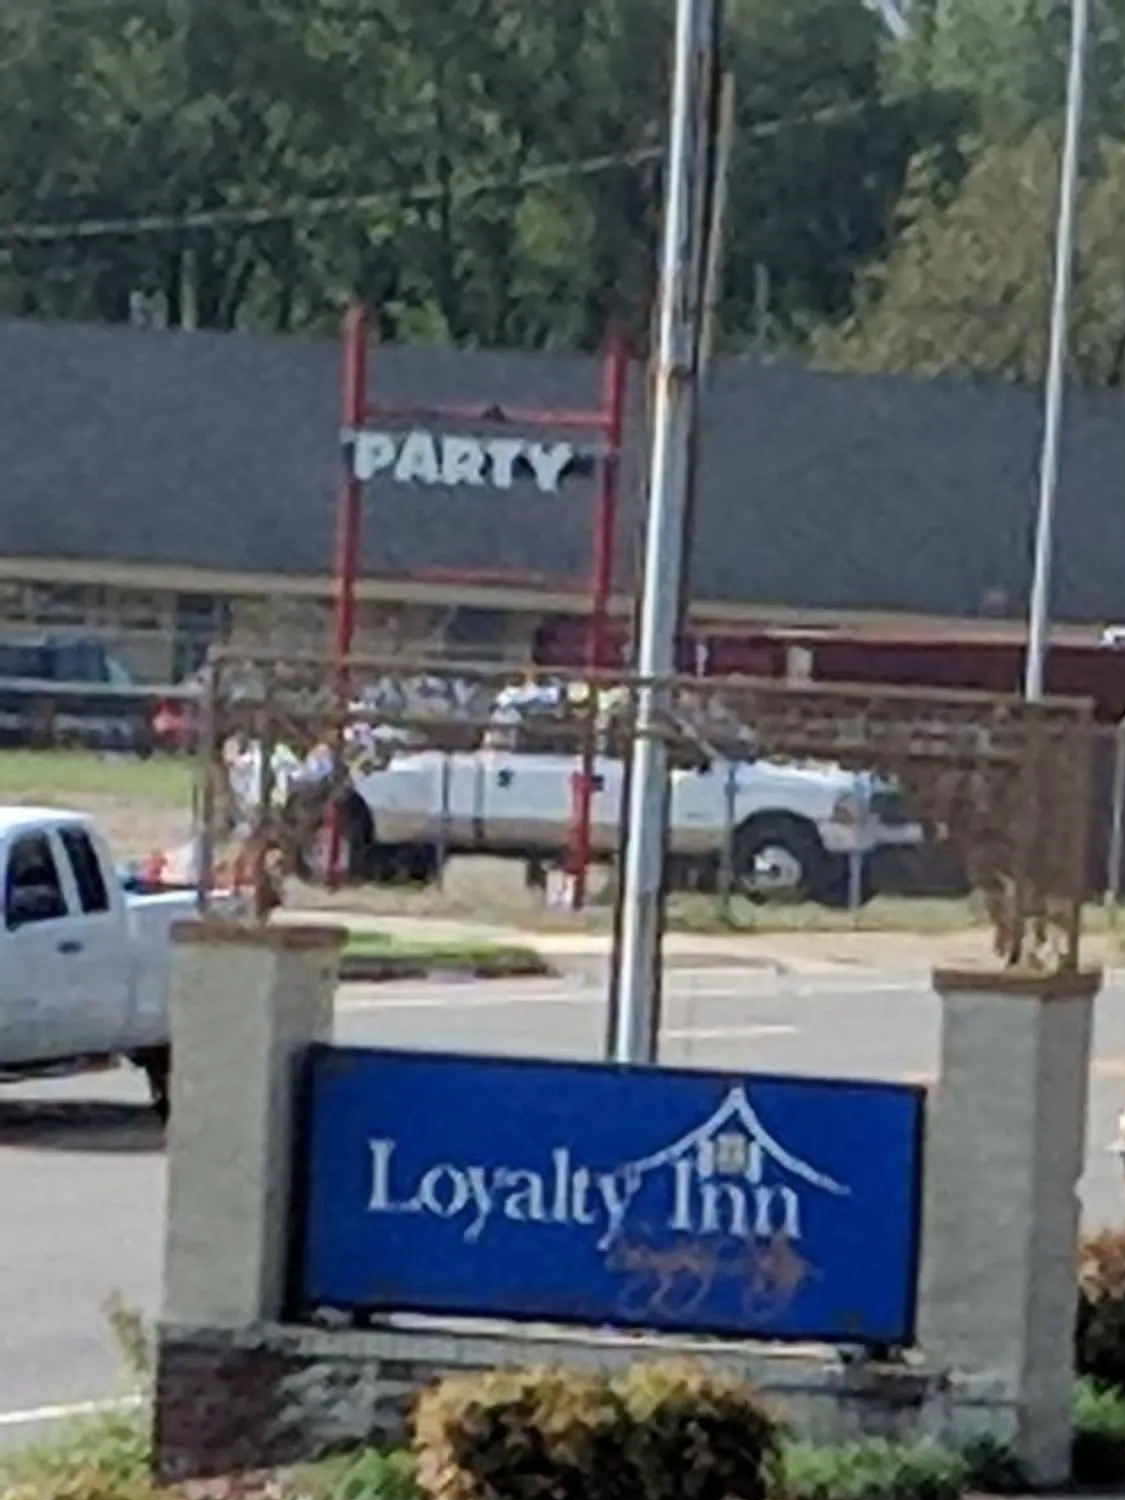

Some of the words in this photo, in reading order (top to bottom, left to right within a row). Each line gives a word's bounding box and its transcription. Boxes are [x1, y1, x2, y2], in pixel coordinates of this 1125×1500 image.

[353, 430, 573, 493] PARTY
[366, 1138, 640, 1249] Loyalty
[670, 1157, 800, 1238] Inn
